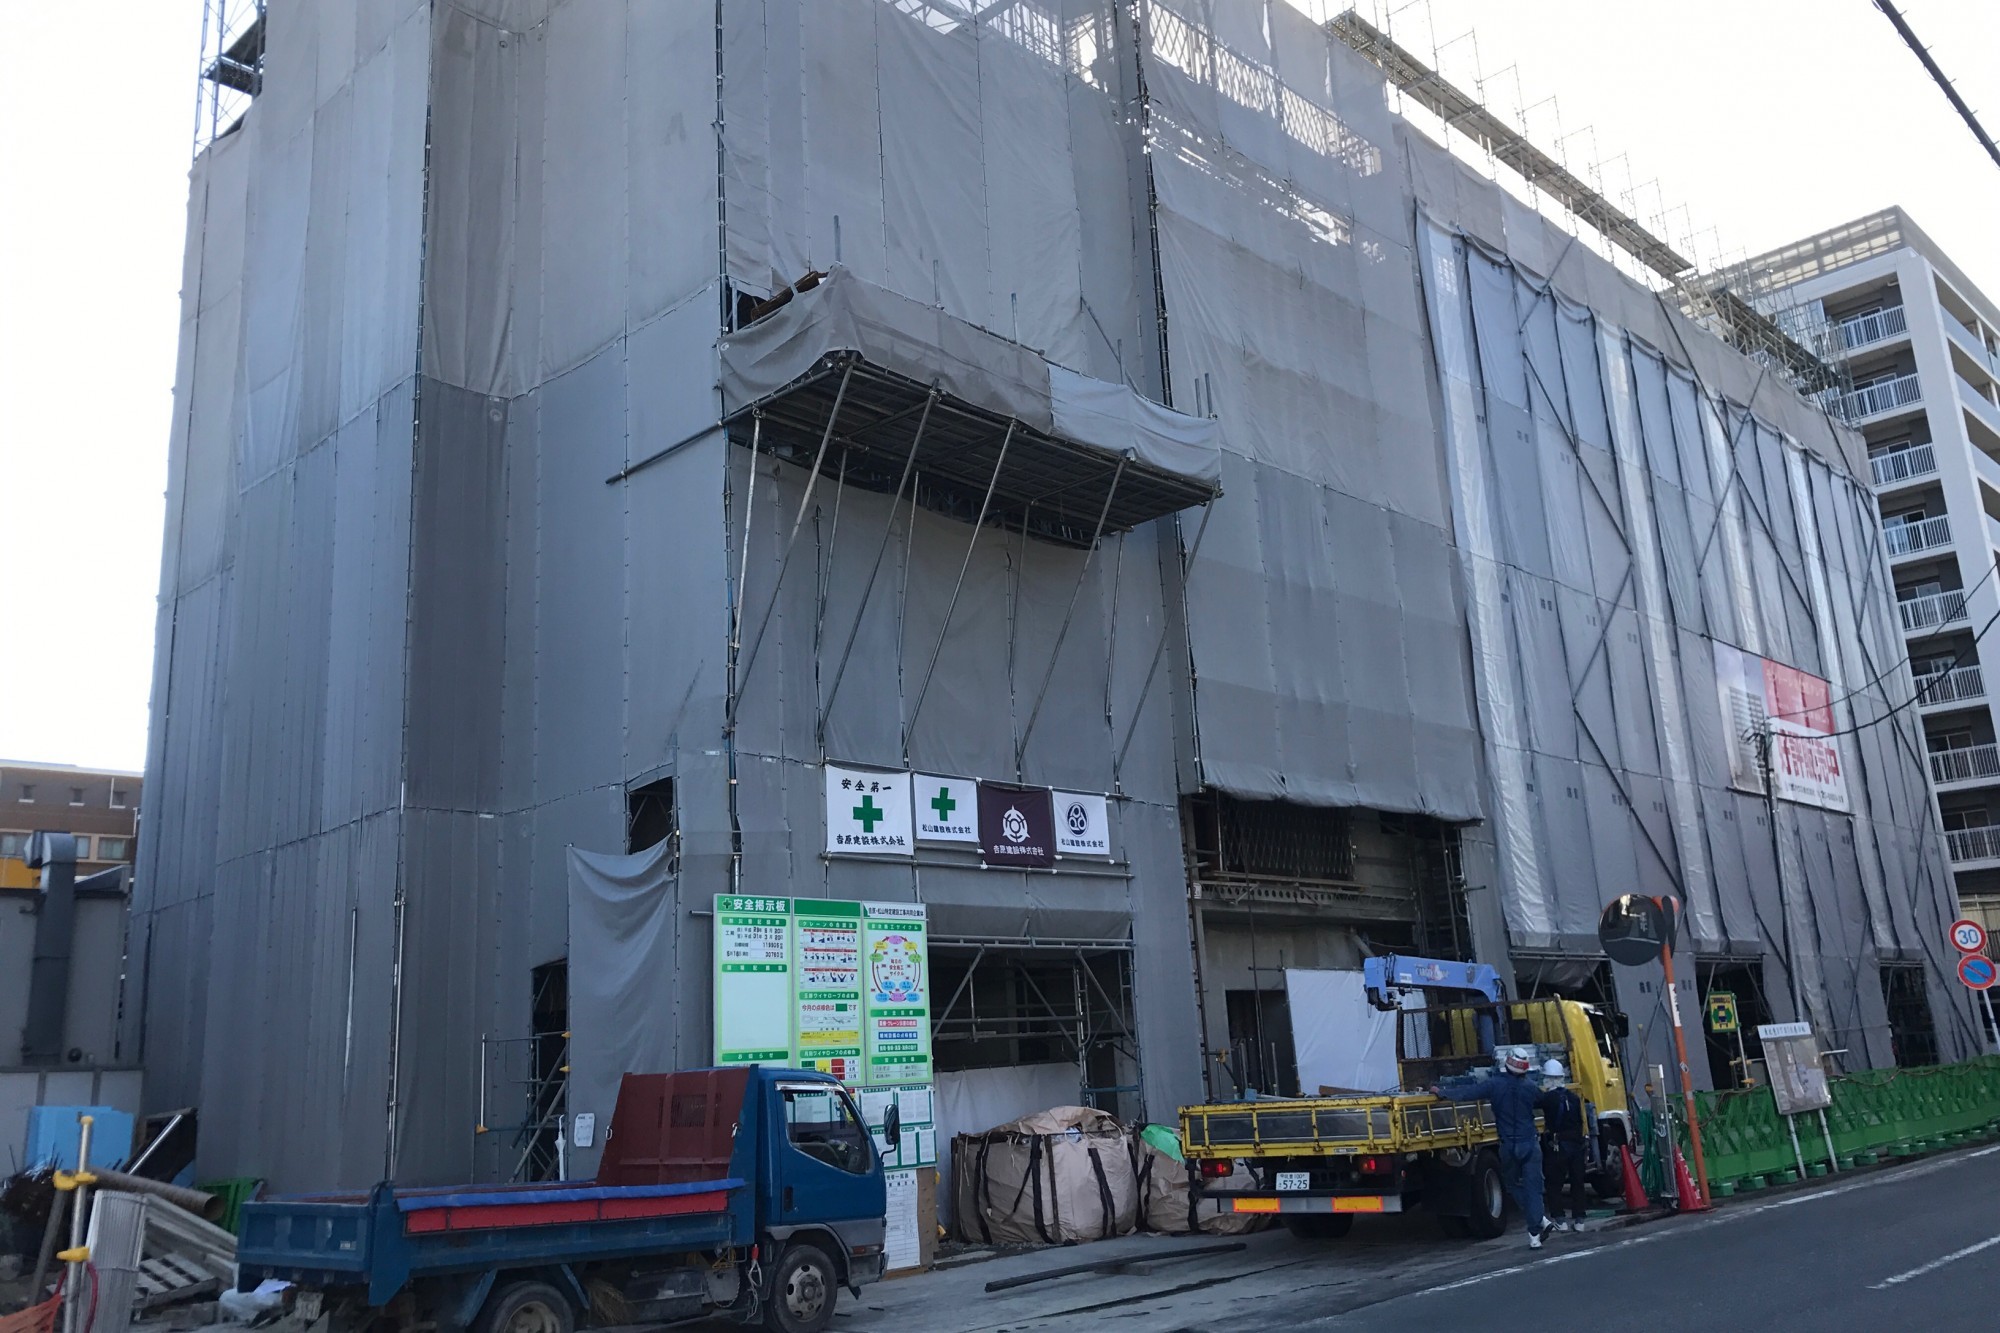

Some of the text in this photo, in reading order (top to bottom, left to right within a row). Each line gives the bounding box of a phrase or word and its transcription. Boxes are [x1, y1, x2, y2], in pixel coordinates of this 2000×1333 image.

[841, 778, 892, 792] 安全第一
[922, 824, 972, 834] 松山建設株式会社
[836, 834, 906, 846] 吉原建設株式会社
[1061, 838, 1105, 848] 松山建設株式会社
[993, 845, 1045, 856] 吉原建設株式会社
[733, 898, 786, 912] 安全掲示板
[1957, 928, 1979, 945] 30
[1283, 1179, 1309, 1190] 57-25
